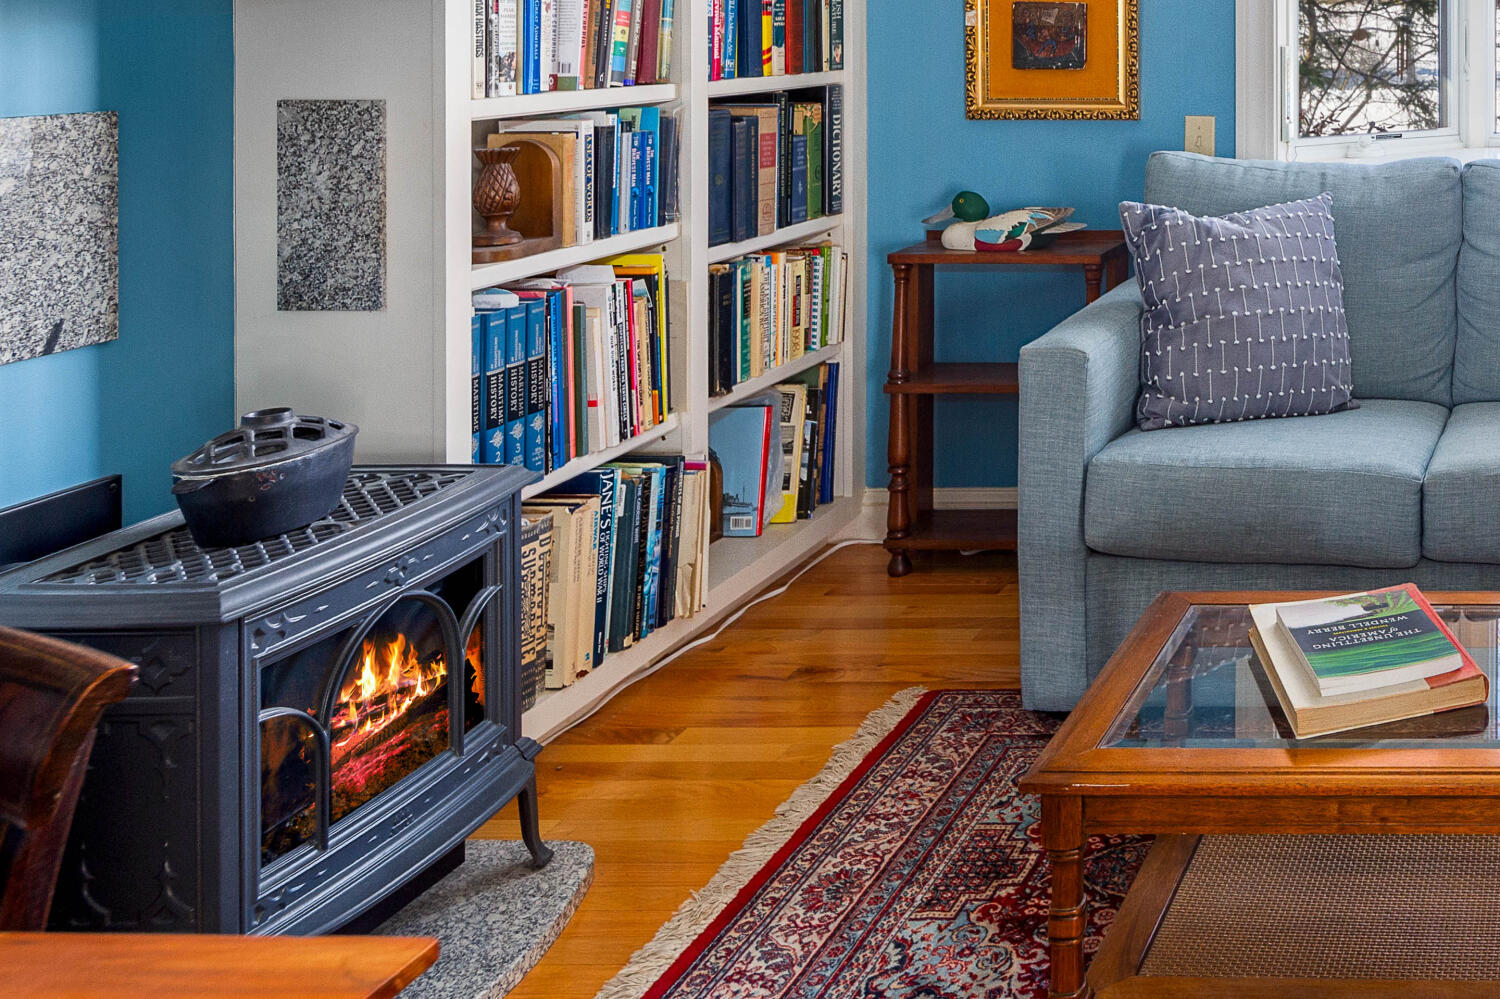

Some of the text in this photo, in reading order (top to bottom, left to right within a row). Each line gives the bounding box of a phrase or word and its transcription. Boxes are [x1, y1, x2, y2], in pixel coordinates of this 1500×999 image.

[475, 18, 484, 58] HASTINGS
[714, 26, 722, 60] Manual
[585, 164, 592, 176] OF
[832, 113, 842, 197] DICTIONARY
[791, 327, 801, 353] 1998
[490, 376, 498, 420] HISTORY
[498, 373, 506, 425] MARITIME
[510, 368, 518, 412] HISTORY
[537, 358, 545, 410] MARITIME
[470, 379, 480, 432] MARITIME
[515, 443, 521, 454] 3
[536, 434, 542, 445] 4
[495, 451, 501, 463] 2
[600, 471, 615, 529] JANE'S
[592, 510, 600, 551] AIRWAR
[600, 532, 606, 543] OF
[598, 544, 606, 576] WORLD
[1307, 615, 1408, 635] WENDELL BERRY
[1312, 628, 1422, 650] THE UNSETTLING
[1328, 626, 1398, 642] of AMERICA
